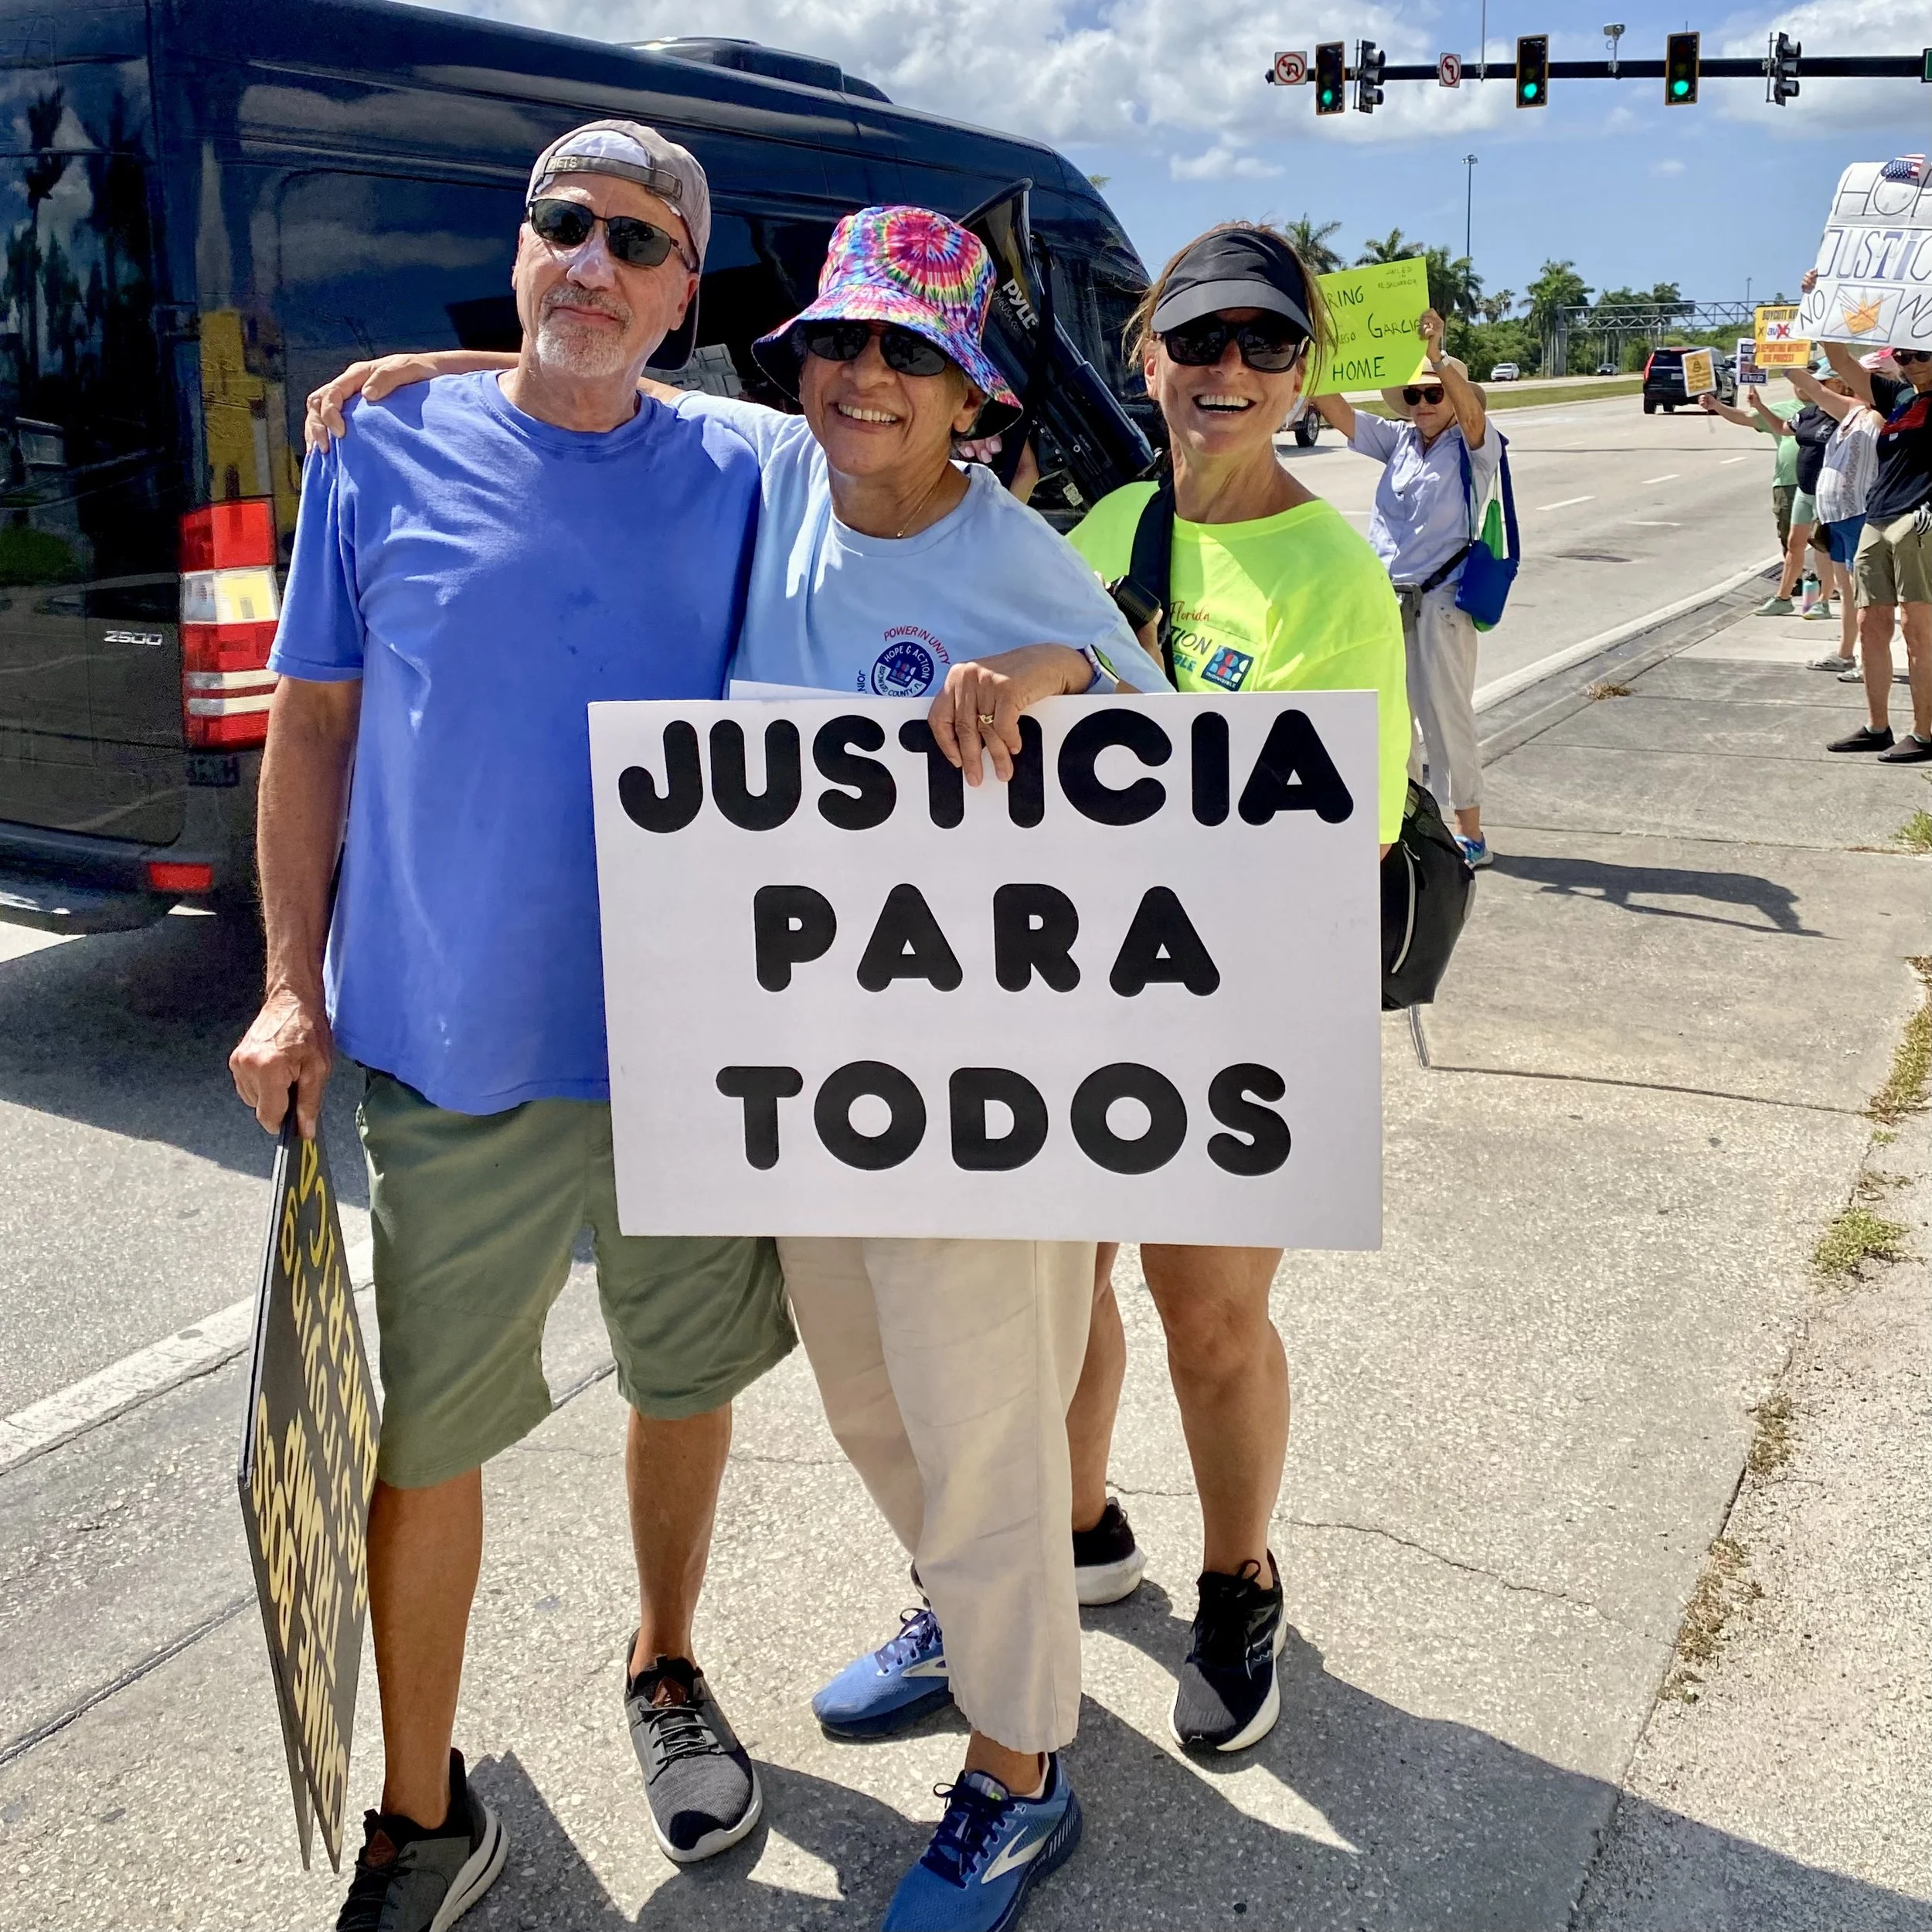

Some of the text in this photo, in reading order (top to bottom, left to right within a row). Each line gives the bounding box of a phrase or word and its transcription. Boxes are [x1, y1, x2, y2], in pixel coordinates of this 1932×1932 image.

[1002, 278, 1039, 330] PYLE
[1326, 285, 1364, 310] RING
[1800, 290, 1825, 330] NO
[1332, 356, 1386, 381] HOME
[1170, 600, 1210, 622] Florida
[104, 631, 162, 646] 2500
[883, 625, 951, 665] POWER IN UNITY
[856, 669, 866, 692] JOIN
[883, 645, 904, 662] HOPE
[913, 649, 930, 679] ACTION
[1206, 671, 1236, 689] INDIVISIBLE
[618, 708, 1355, 834] JUSTICIA
[753, 883, 1220, 996] PARA
[716, 1060, 1291, 1177] TODOS
[299, 1138, 377, 1507] AMERICA
[281, 1186, 368, 1624] destroying
[284, 1409, 342, 1689] TRUMP
[253, 1392, 347, 1855] CRIME BOSS
